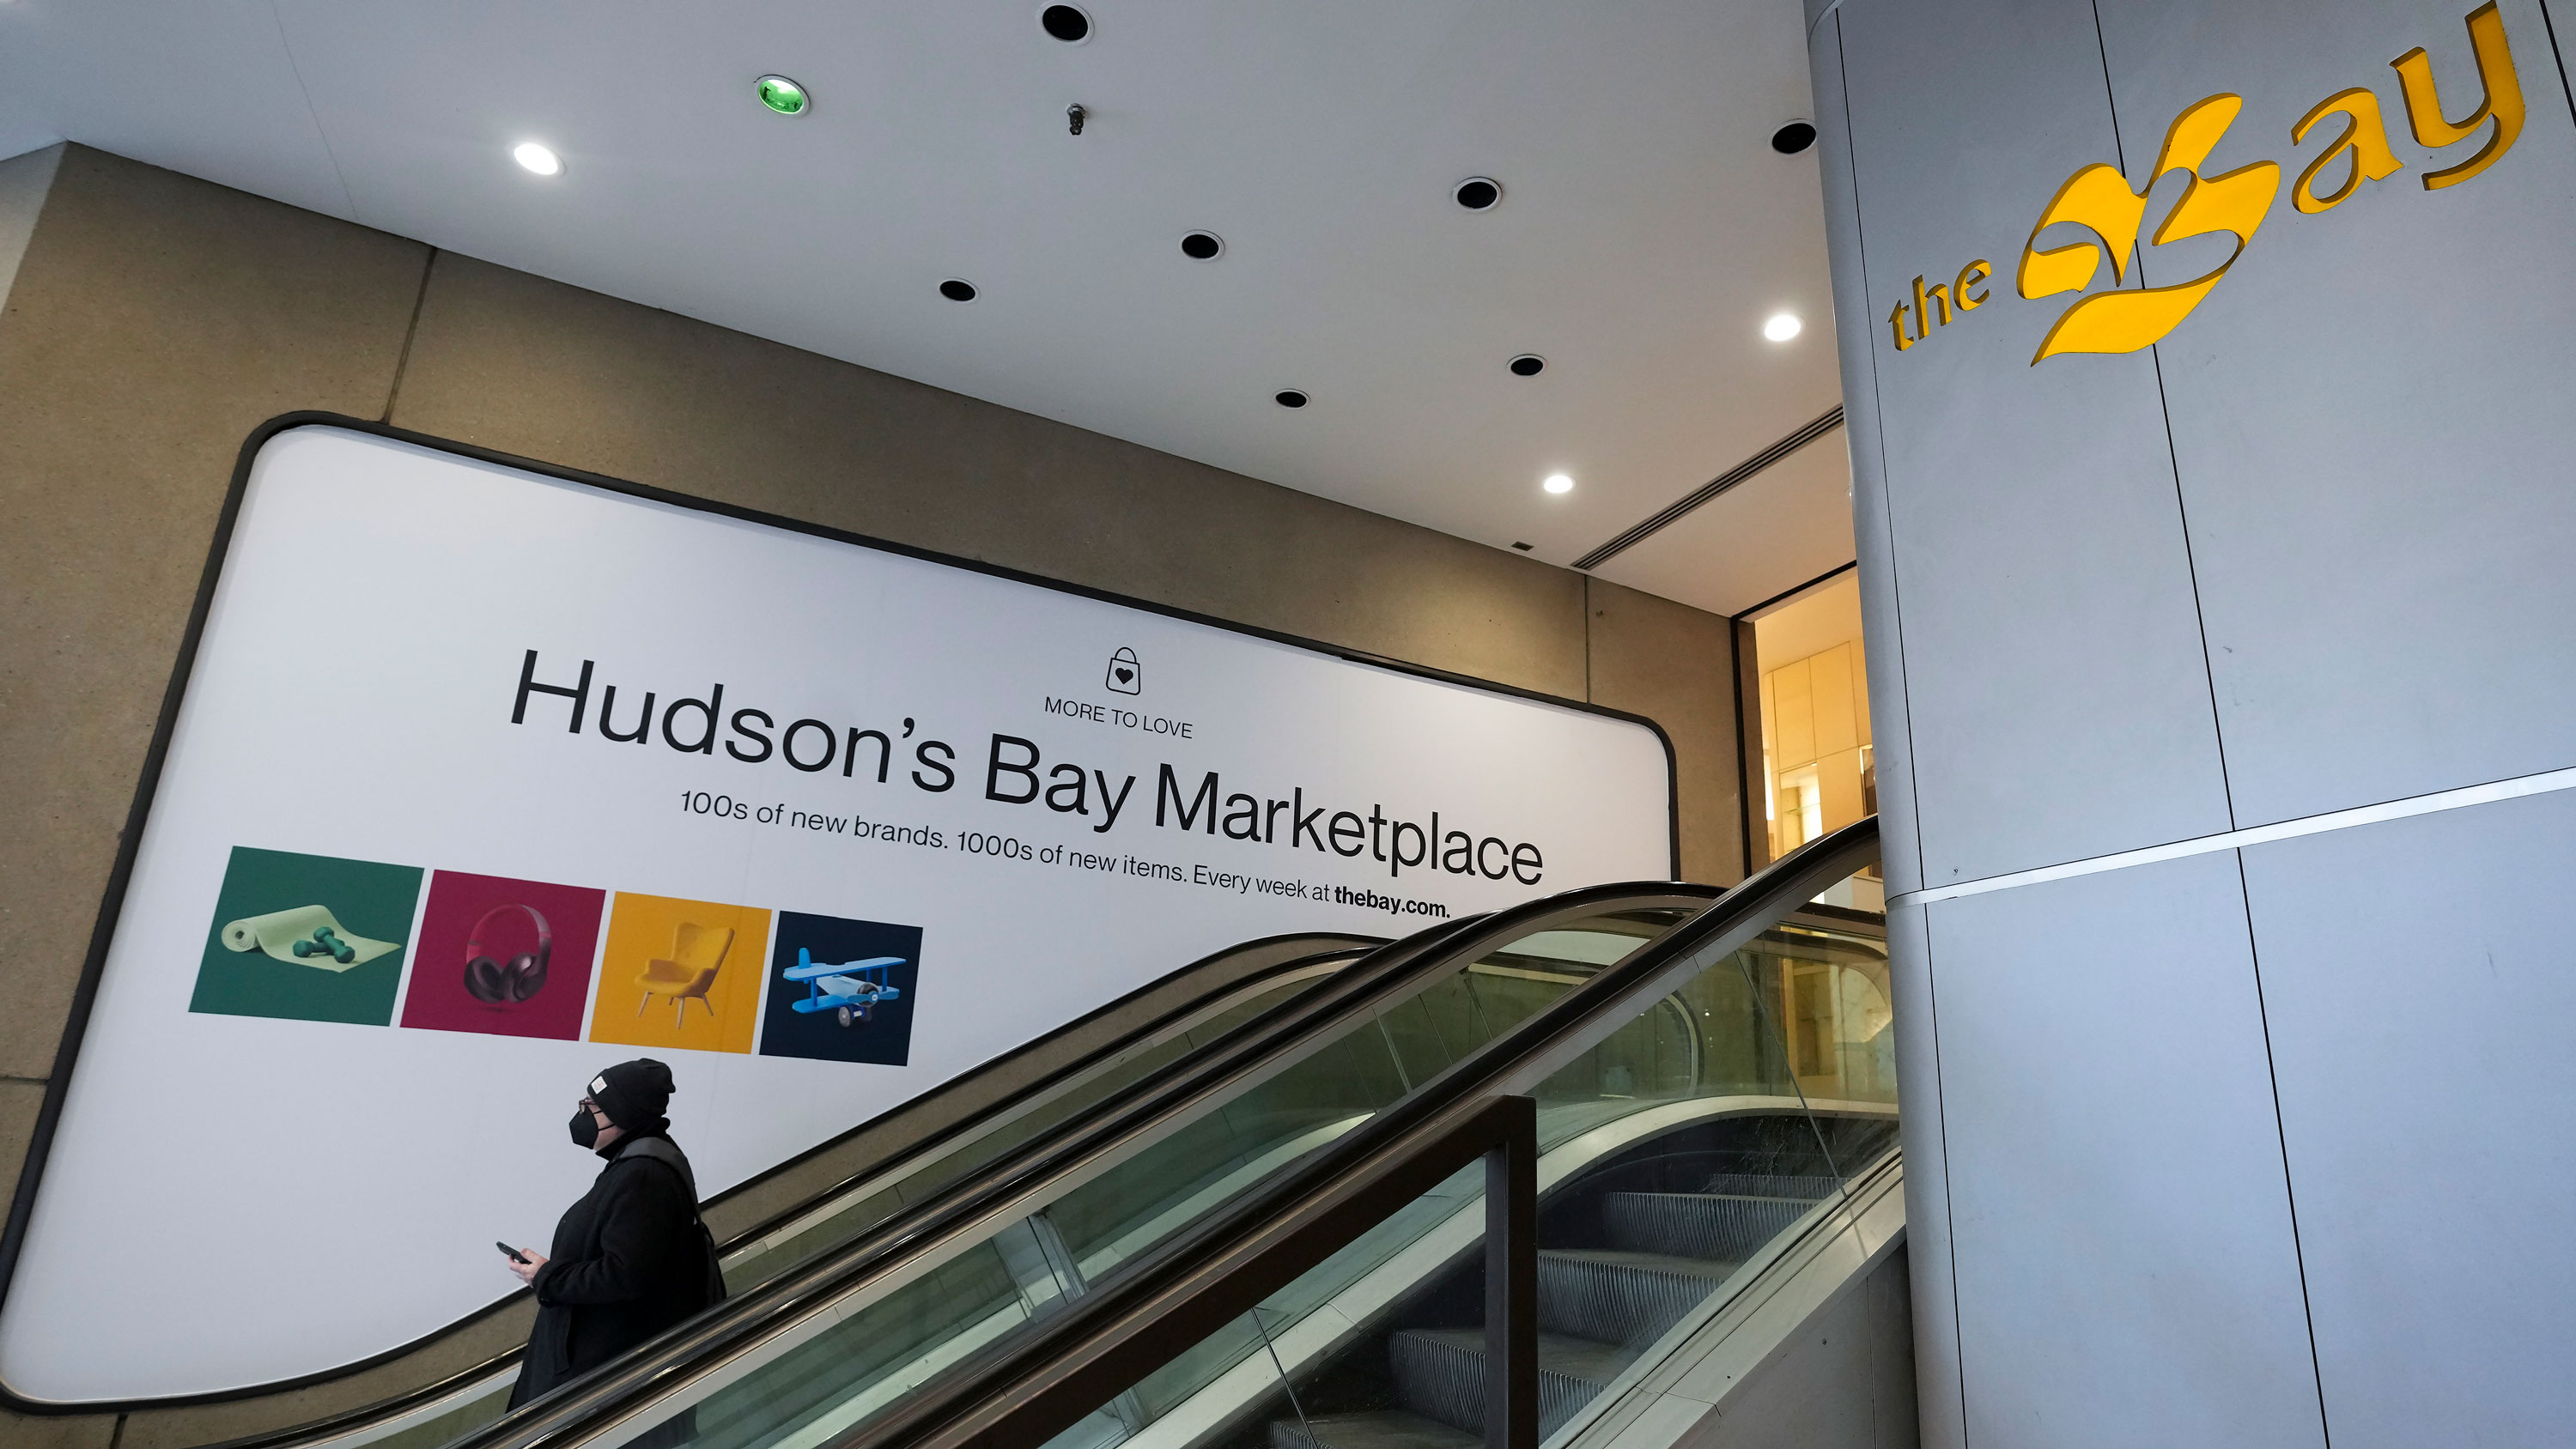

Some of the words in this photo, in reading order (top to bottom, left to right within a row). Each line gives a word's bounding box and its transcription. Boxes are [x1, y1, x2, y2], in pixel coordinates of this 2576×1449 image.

[1889, 259, 1991, 352] the
[2016, 0, 2526, 367] Bay
[510, 649, 956, 793] Hudson’s
[985, 732, 1137, 834] Bay
[1155, 762, 1544, 886] Marketplace
[1044, 696, 1106, 726] MORE
[1110, 708, 1138, 729] TO
[1143, 715, 1194, 740] LOVE
[681, 790, 748, 820] 100s
[756, 803, 785, 825] of
[791, 811, 848, 834] new
[854, 815, 948, 849] brands.
[957, 831, 1033, 861] 1000s
[1039, 844, 1064, 865] of
[1069, 852, 1117, 872] new
[1123, 854, 1188, 883] items.
[1194, 864, 1252, 894] Every
[1255, 877, 1308, 900] week
[1311, 883, 1330, 902] at
[1334, 885, 1451, 919] thebay.com.
